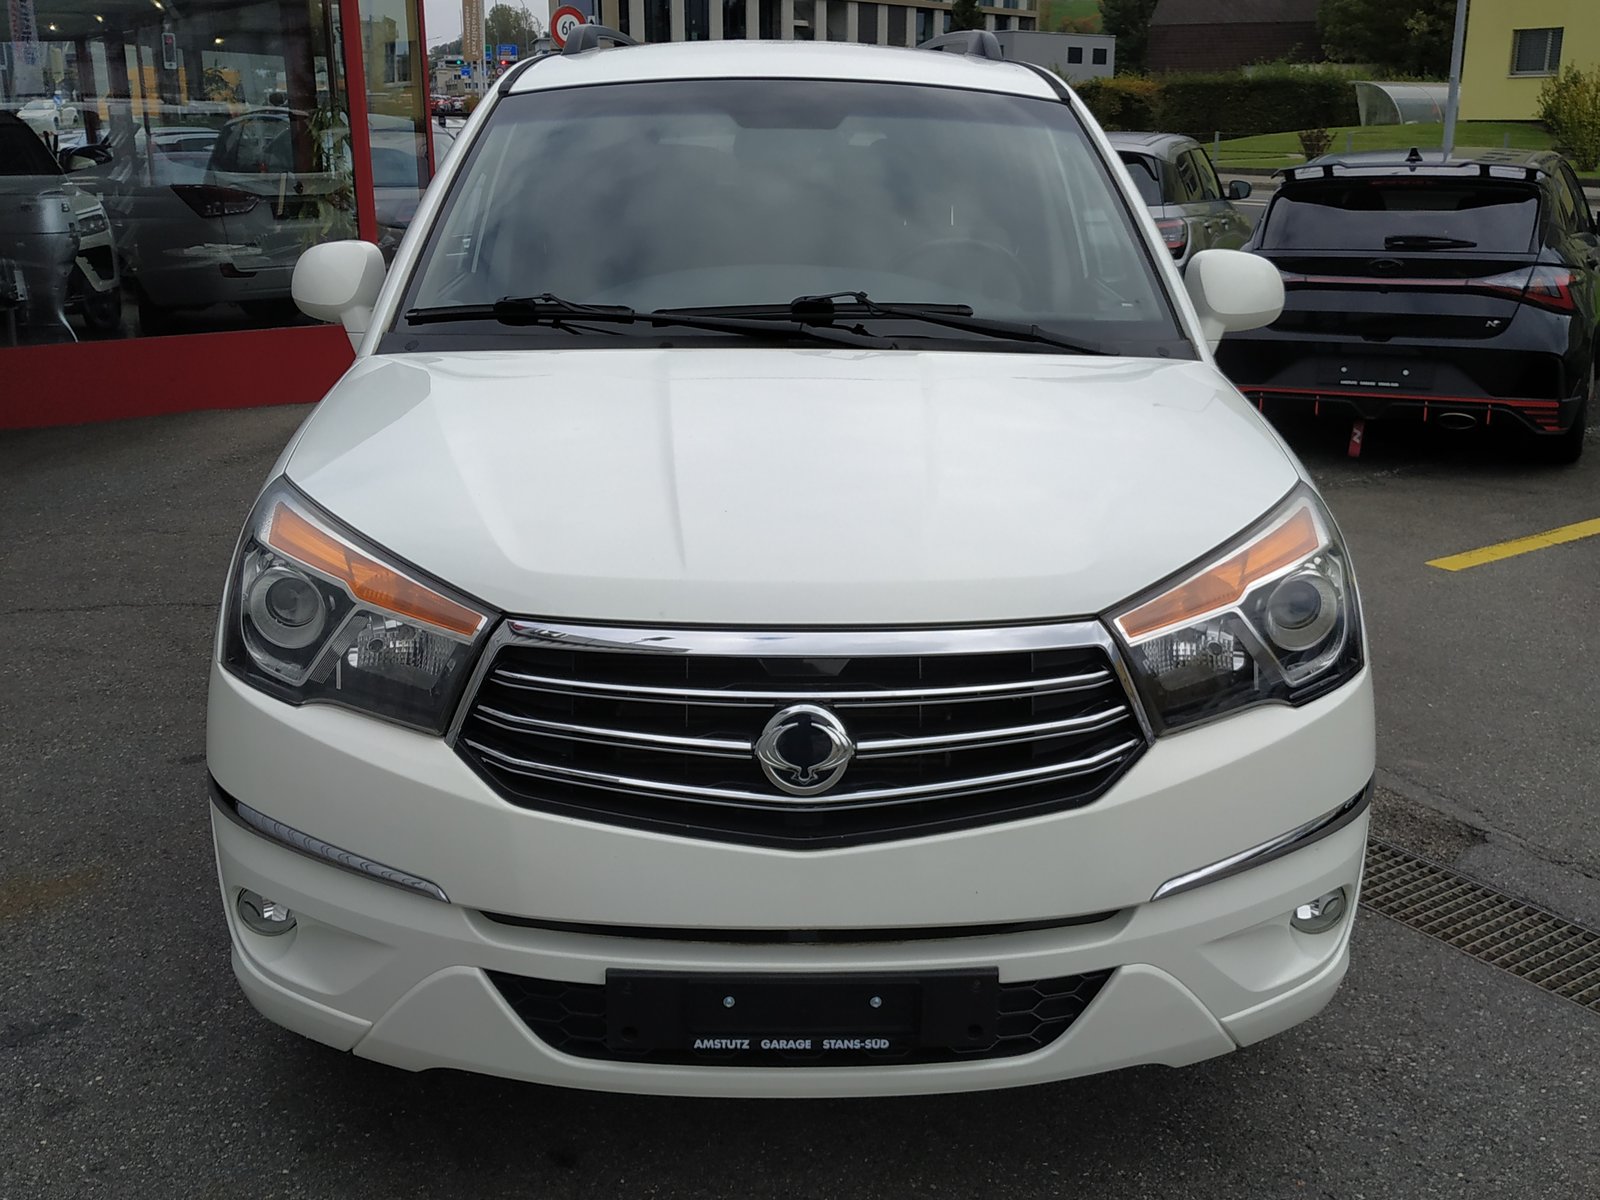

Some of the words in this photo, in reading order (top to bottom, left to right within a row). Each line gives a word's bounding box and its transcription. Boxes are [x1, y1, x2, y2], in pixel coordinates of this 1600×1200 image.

[693, 1038, 750, 1049] AMSTUTZ
[760, 1038, 812, 1049] GARAGE
[822, 1037, 890, 1049] STANS-SÜD
